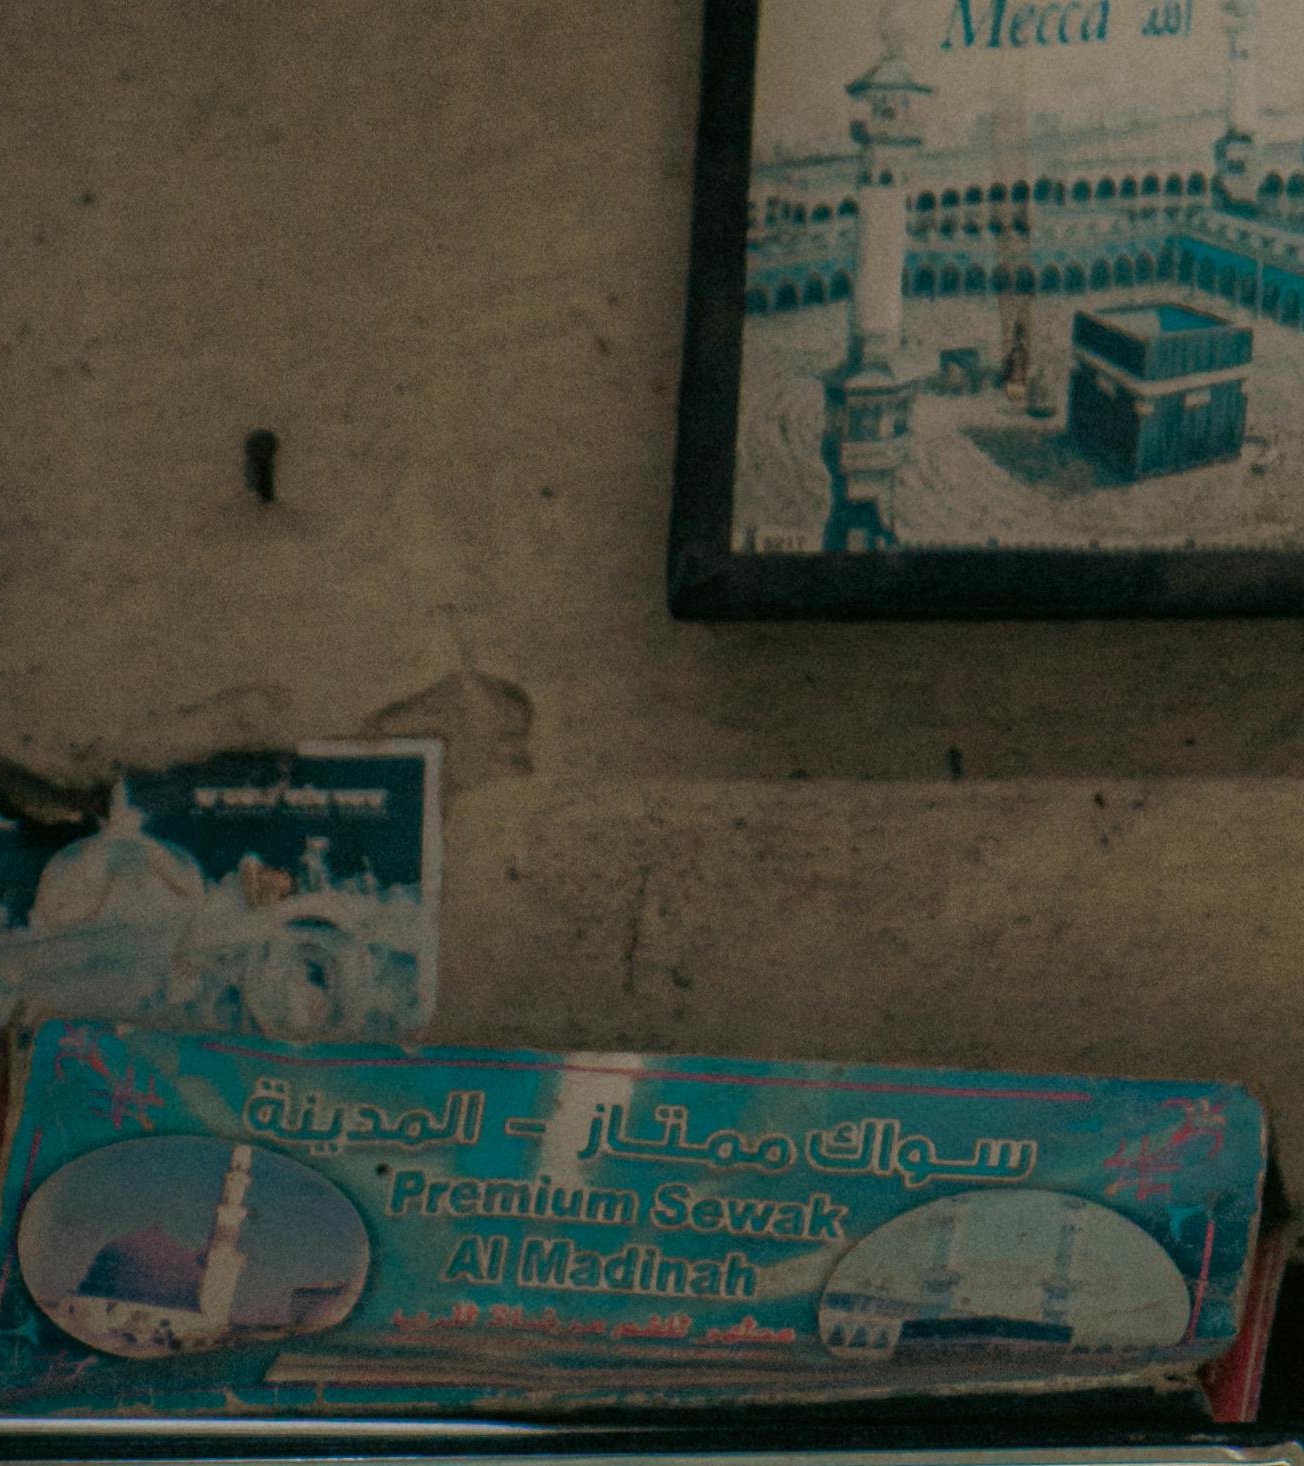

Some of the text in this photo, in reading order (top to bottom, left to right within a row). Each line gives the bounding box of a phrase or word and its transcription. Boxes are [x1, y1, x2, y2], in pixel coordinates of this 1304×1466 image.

[243, 1079, 484, 1157] المدينة
[581, 1103, 796, 1170] ممتاز
[806, 1119, 1038, 1182] سواك
[386, 1167, 847, 1243] Premium Sewak
[442, 1235, 759, 1299] Al Madinah
